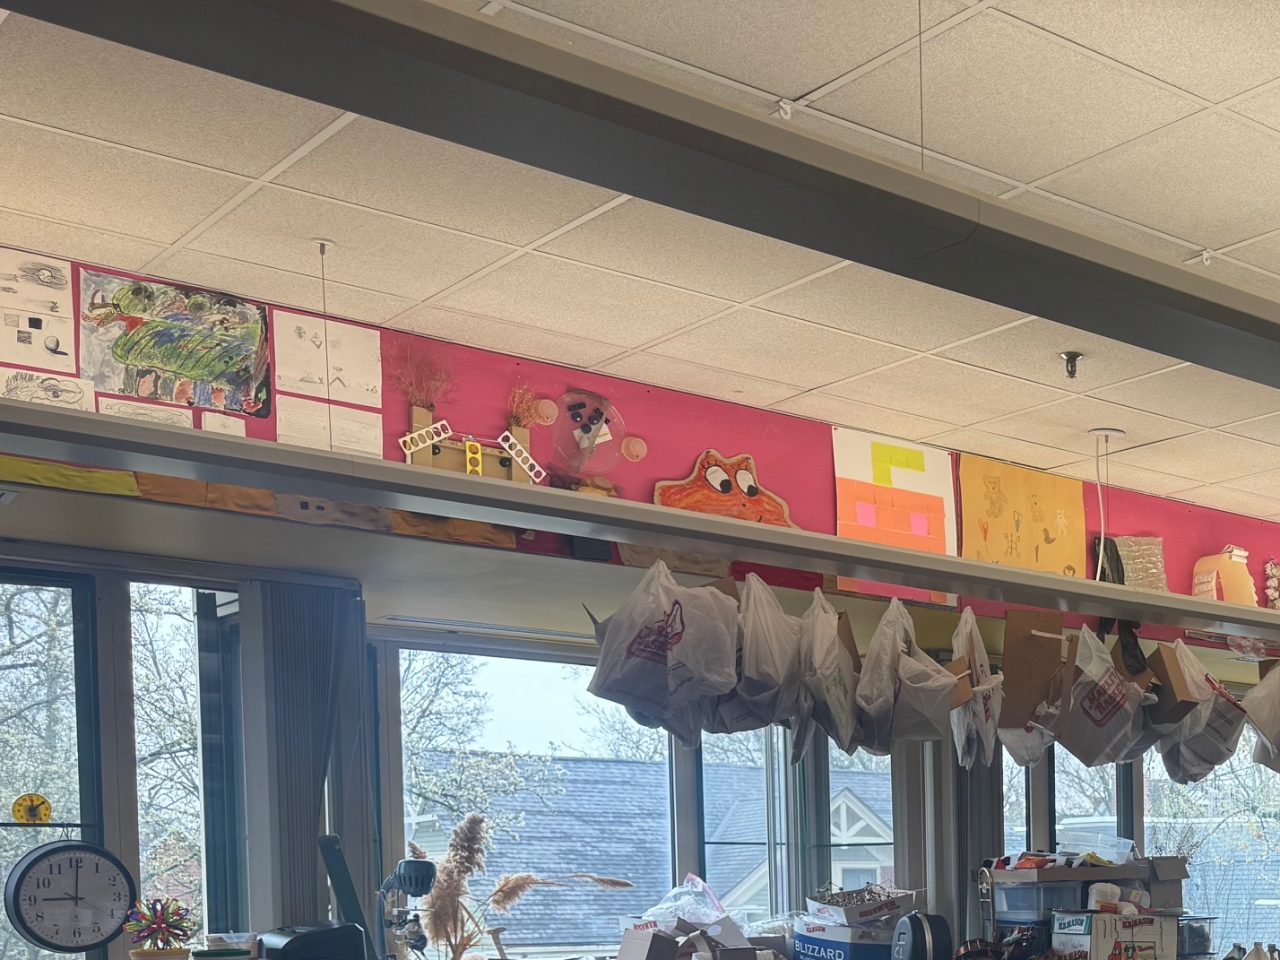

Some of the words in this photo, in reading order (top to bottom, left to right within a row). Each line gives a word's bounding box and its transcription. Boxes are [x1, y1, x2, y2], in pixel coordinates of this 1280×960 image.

[48, 863, 62, 875] 11
[68, 857, 83, 869] 12
[36, 877, 51, 889] 10
[108, 876, 116, 887] 2
[28, 894, 37, 906] 9
[113, 892, 121, 903] 3
[35, 911, 44, 922] 8
[53, 923, 59, 935] 7
[73, 928, 81, 938] 6
[92, 922, 101, 933] 5
[795, 940, 845, 960] BLIZZARD
